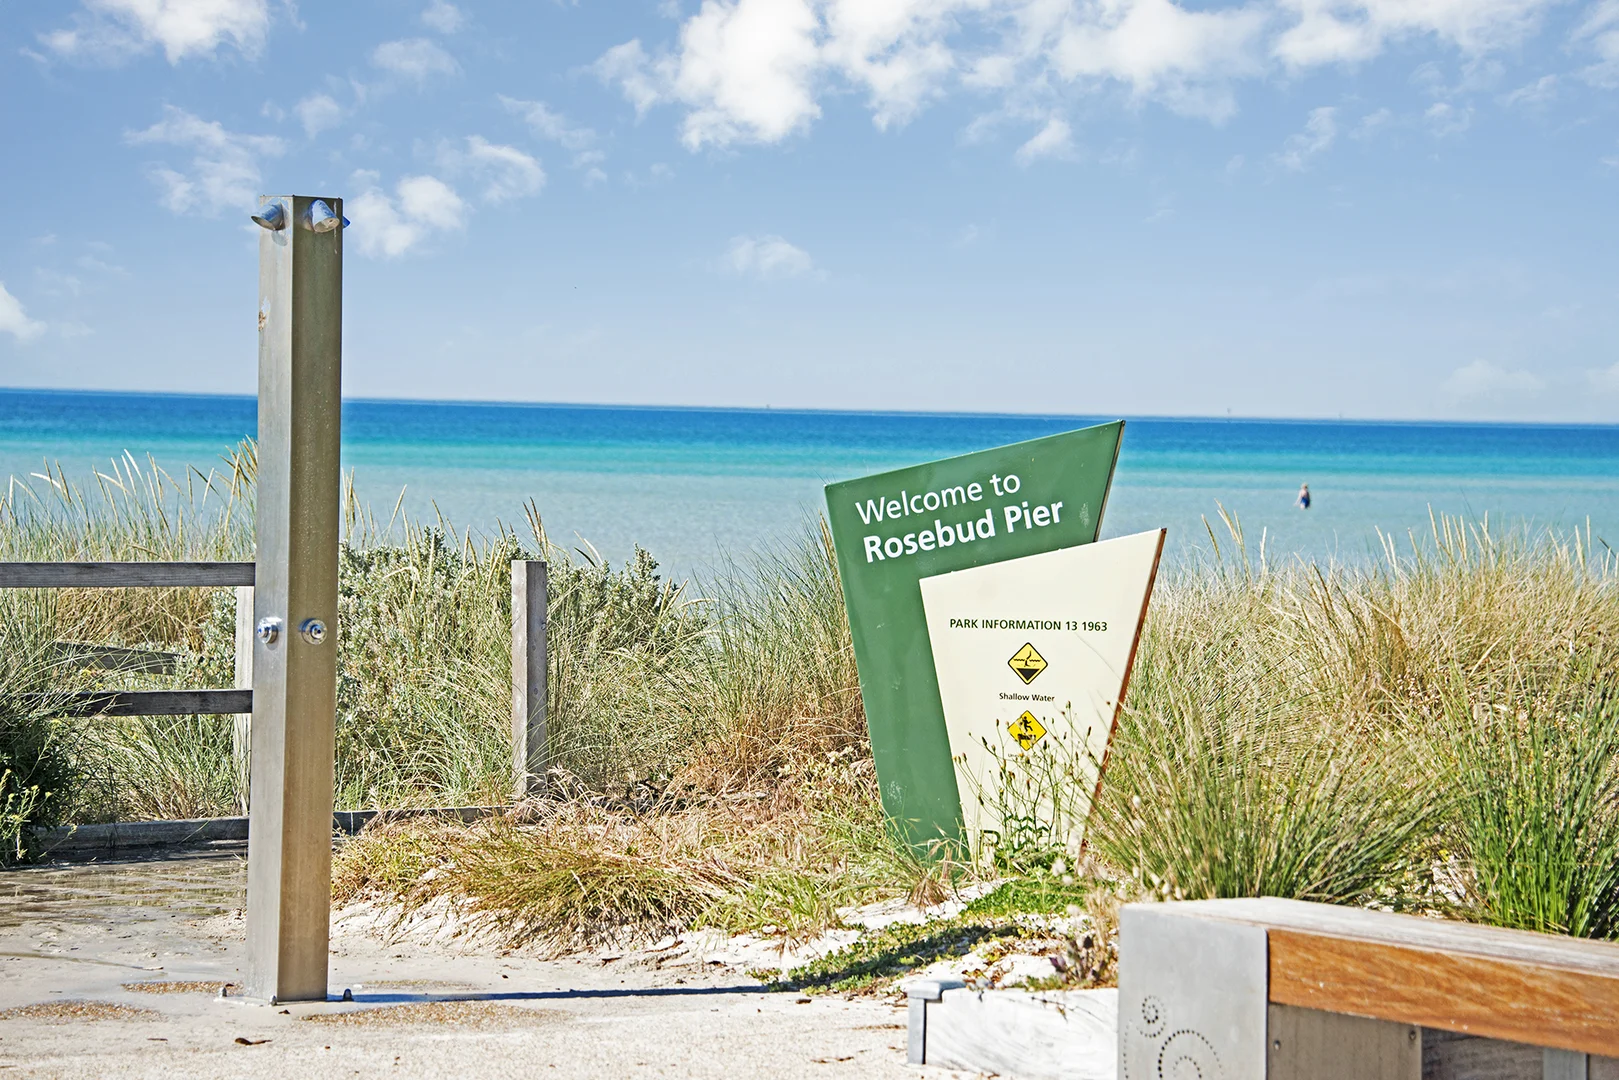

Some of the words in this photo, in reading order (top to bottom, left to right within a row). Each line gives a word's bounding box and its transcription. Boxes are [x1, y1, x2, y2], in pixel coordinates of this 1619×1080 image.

[855, 481, 983, 525] Welcome
[989, 473, 1021, 497] to
[863, 508, 996, 563] Rosebud
[1003, 501, 1064, 534] Pier
[949, 618, 978, 629] PARK
[982, 619, 1061, 631] INFORMATION
[1065, 621, 1078, 631] 13
[1082, 621, 1108, 632] 1963
[999, 692, 1030, 701] Shallow
[1031, 694, 1055, 702] Water
